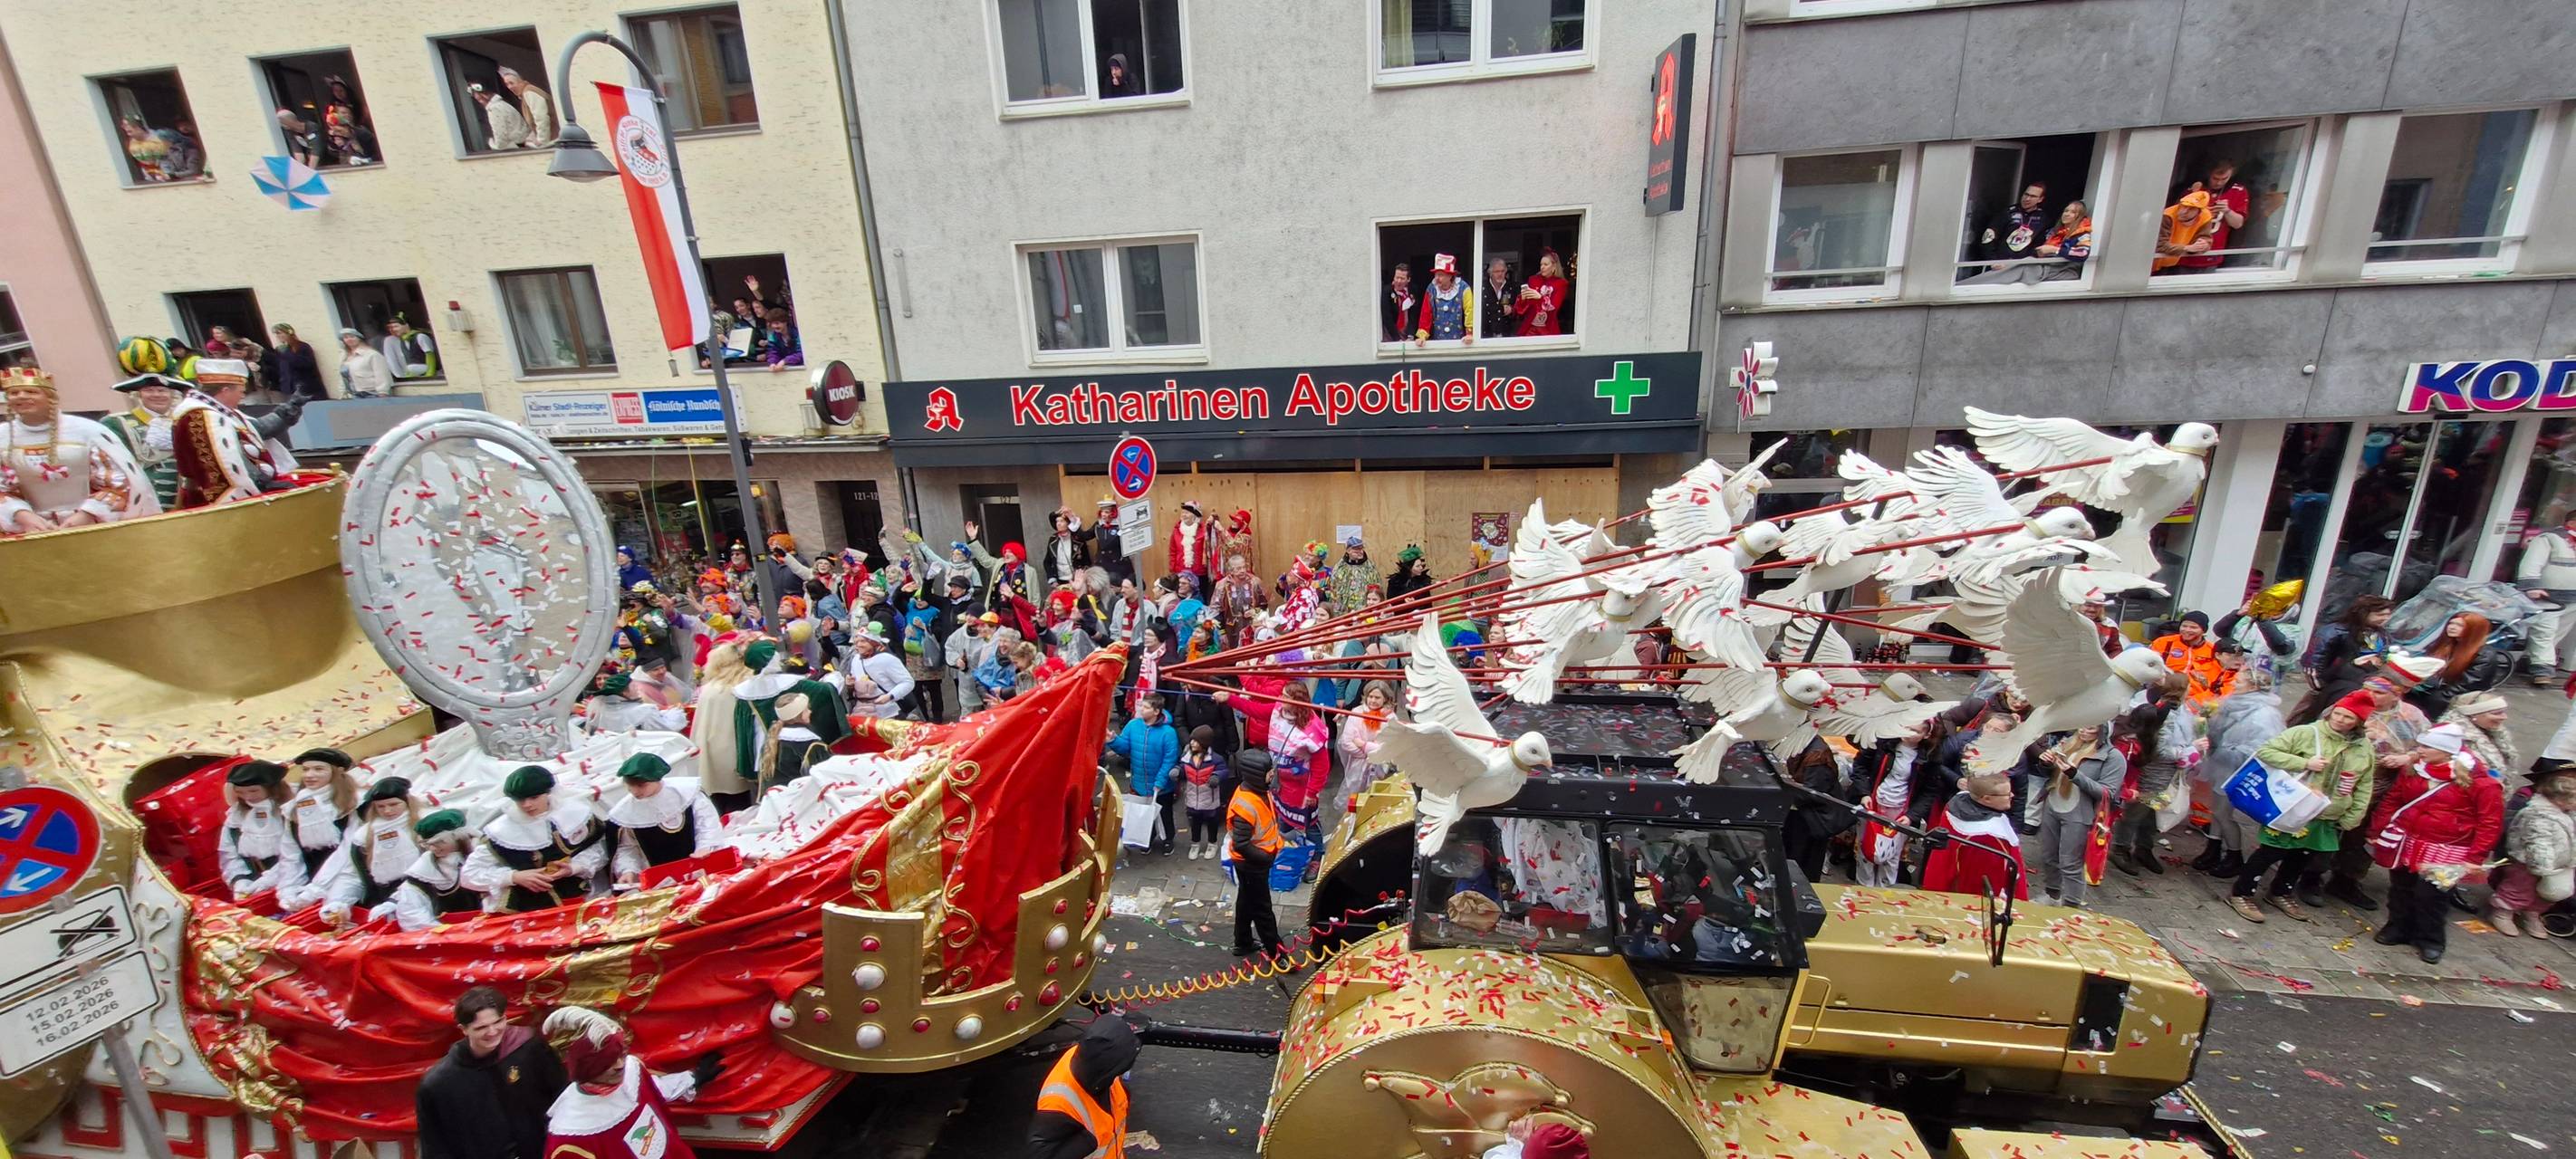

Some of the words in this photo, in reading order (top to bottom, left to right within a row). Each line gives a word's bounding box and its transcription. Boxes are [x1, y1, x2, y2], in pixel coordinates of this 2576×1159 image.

[687, 399, 721, 411] Rundsch
[828, 386, 855, 402] KIOSK
[1010, 379, 1269, 426] Katharinen
[1284, 367, 1536, 426] Apotheke
[27, 976, 110, 1021] 12.02.2026
[31, 988, 114, 1034] 15.02.2026
[36, 1000, 120, 1047] 16.02.2026
